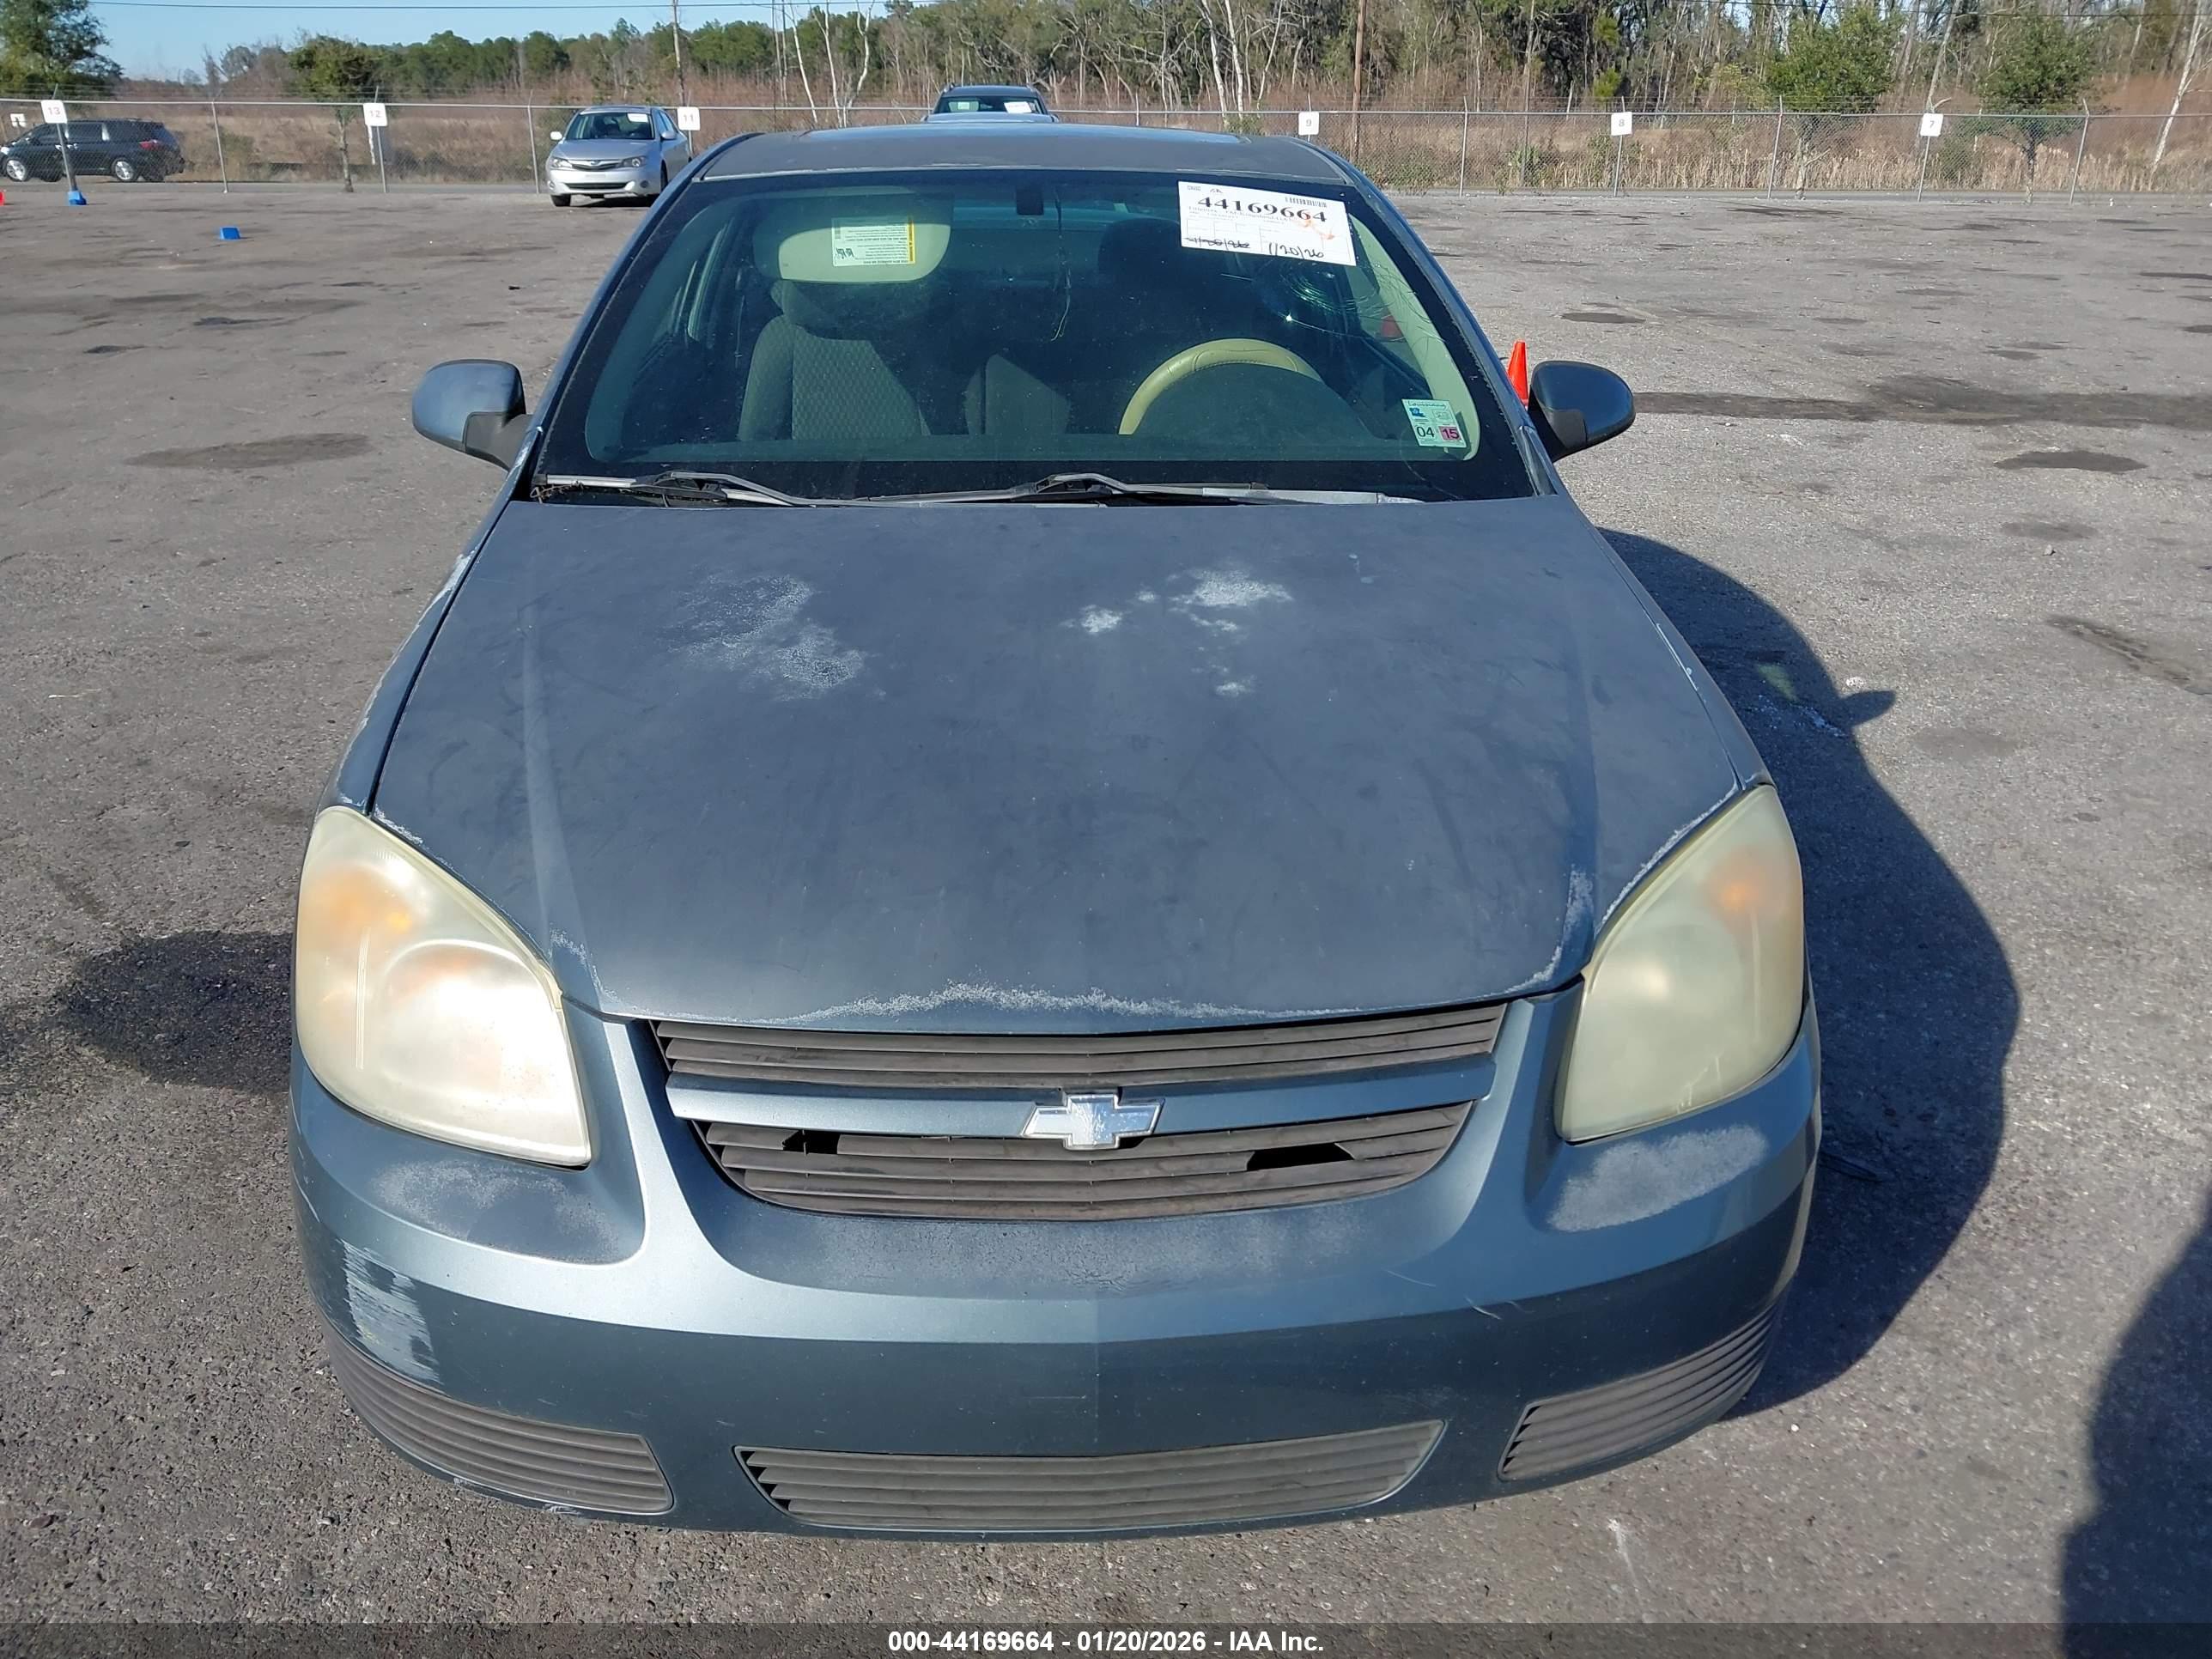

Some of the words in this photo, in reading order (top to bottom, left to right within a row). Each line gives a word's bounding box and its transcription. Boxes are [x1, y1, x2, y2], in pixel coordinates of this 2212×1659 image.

[1198, 197, 1328, 222] 44169664
[1416, 426, 1435, 438] 04
[1443, 428, 1460, 440] 15
